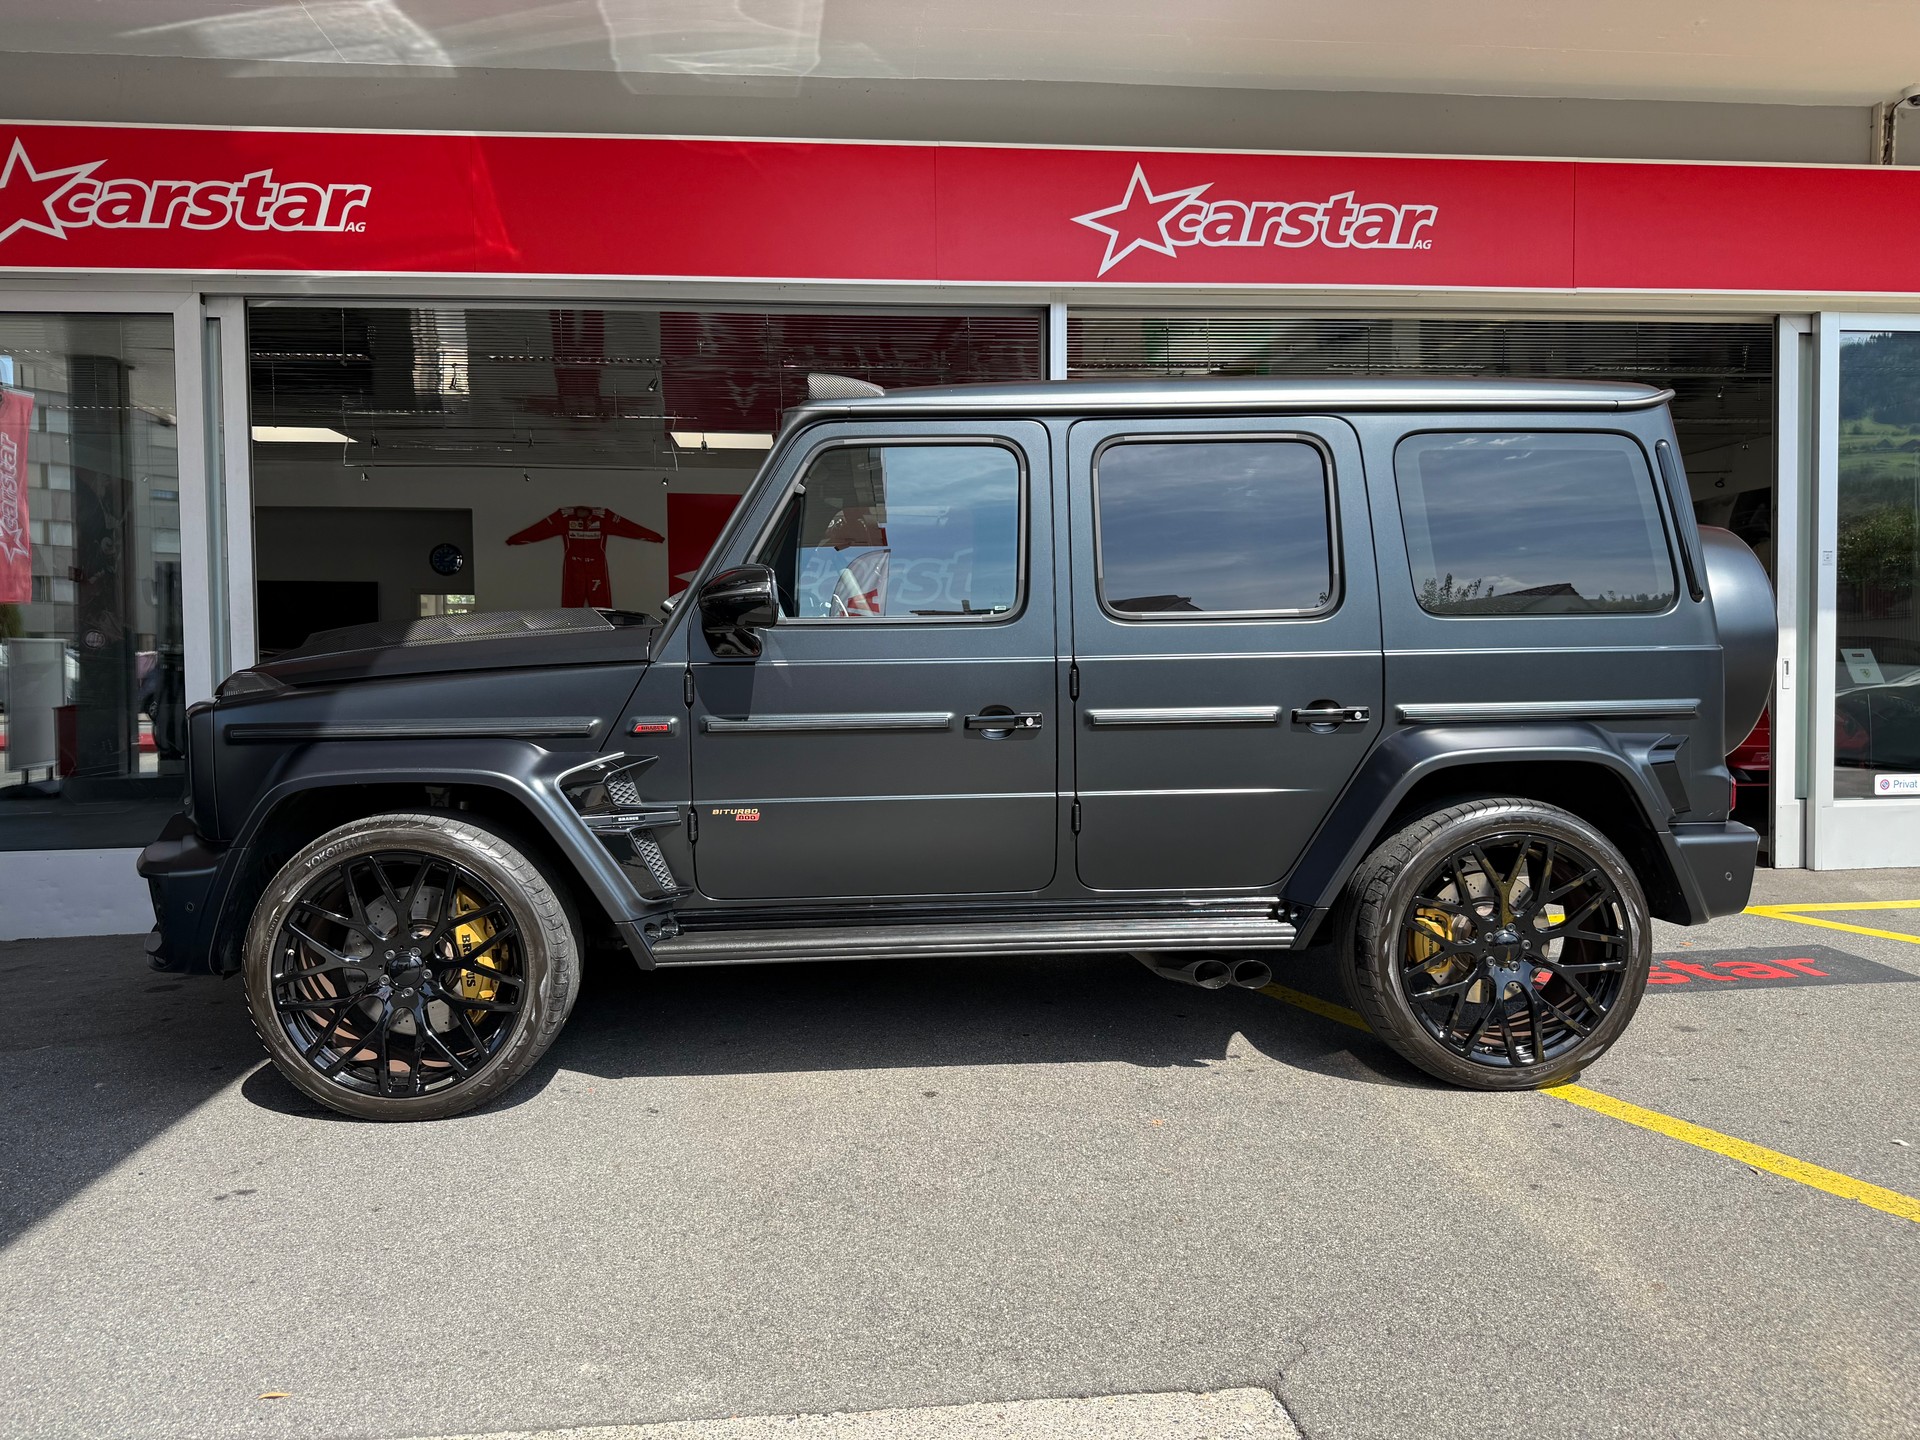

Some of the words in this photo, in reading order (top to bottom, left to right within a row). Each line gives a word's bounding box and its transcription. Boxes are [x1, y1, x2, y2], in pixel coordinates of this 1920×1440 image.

[49, 168, 372, 232] carstar
[344, 221, 367, 233] AG
[1161, 190, 1439, 249] carstar
[1413, 239, 1433, 250] AG
[1893, 779, 1918, 789] Privat
[305, 835, 373, 870] YOKOHAMA
[461, 933, 476, 988] BRUS
